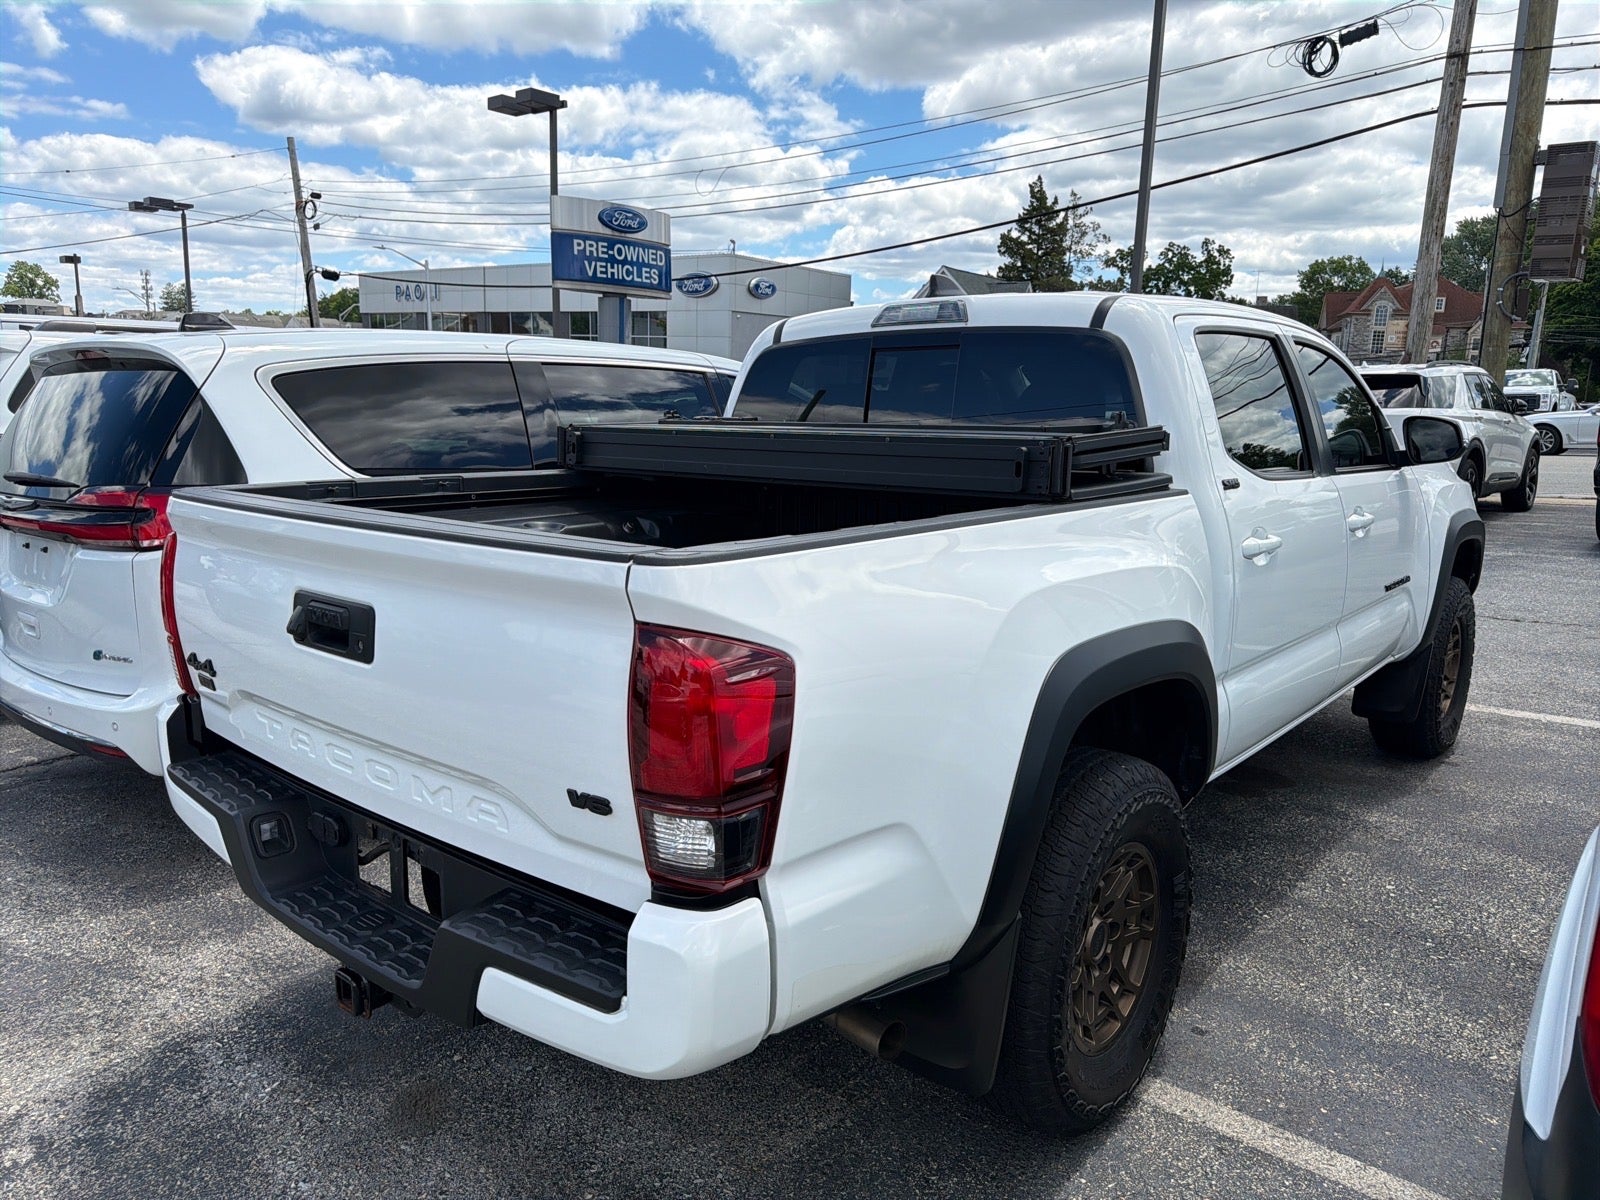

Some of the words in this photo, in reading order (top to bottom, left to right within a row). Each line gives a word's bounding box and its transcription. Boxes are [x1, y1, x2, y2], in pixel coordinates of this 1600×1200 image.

[612, 209, 640, 229] Ford
[573, 238, 666, 267] PRE-OWNED
[584, 260, 660, 285] VEHICLES
[681, 277, 706, 292] Ford
[395, 283, 438, 301] PAOI
[255, 709, 509, 833] TACOMA
[566, 788, 613, 816] V6
